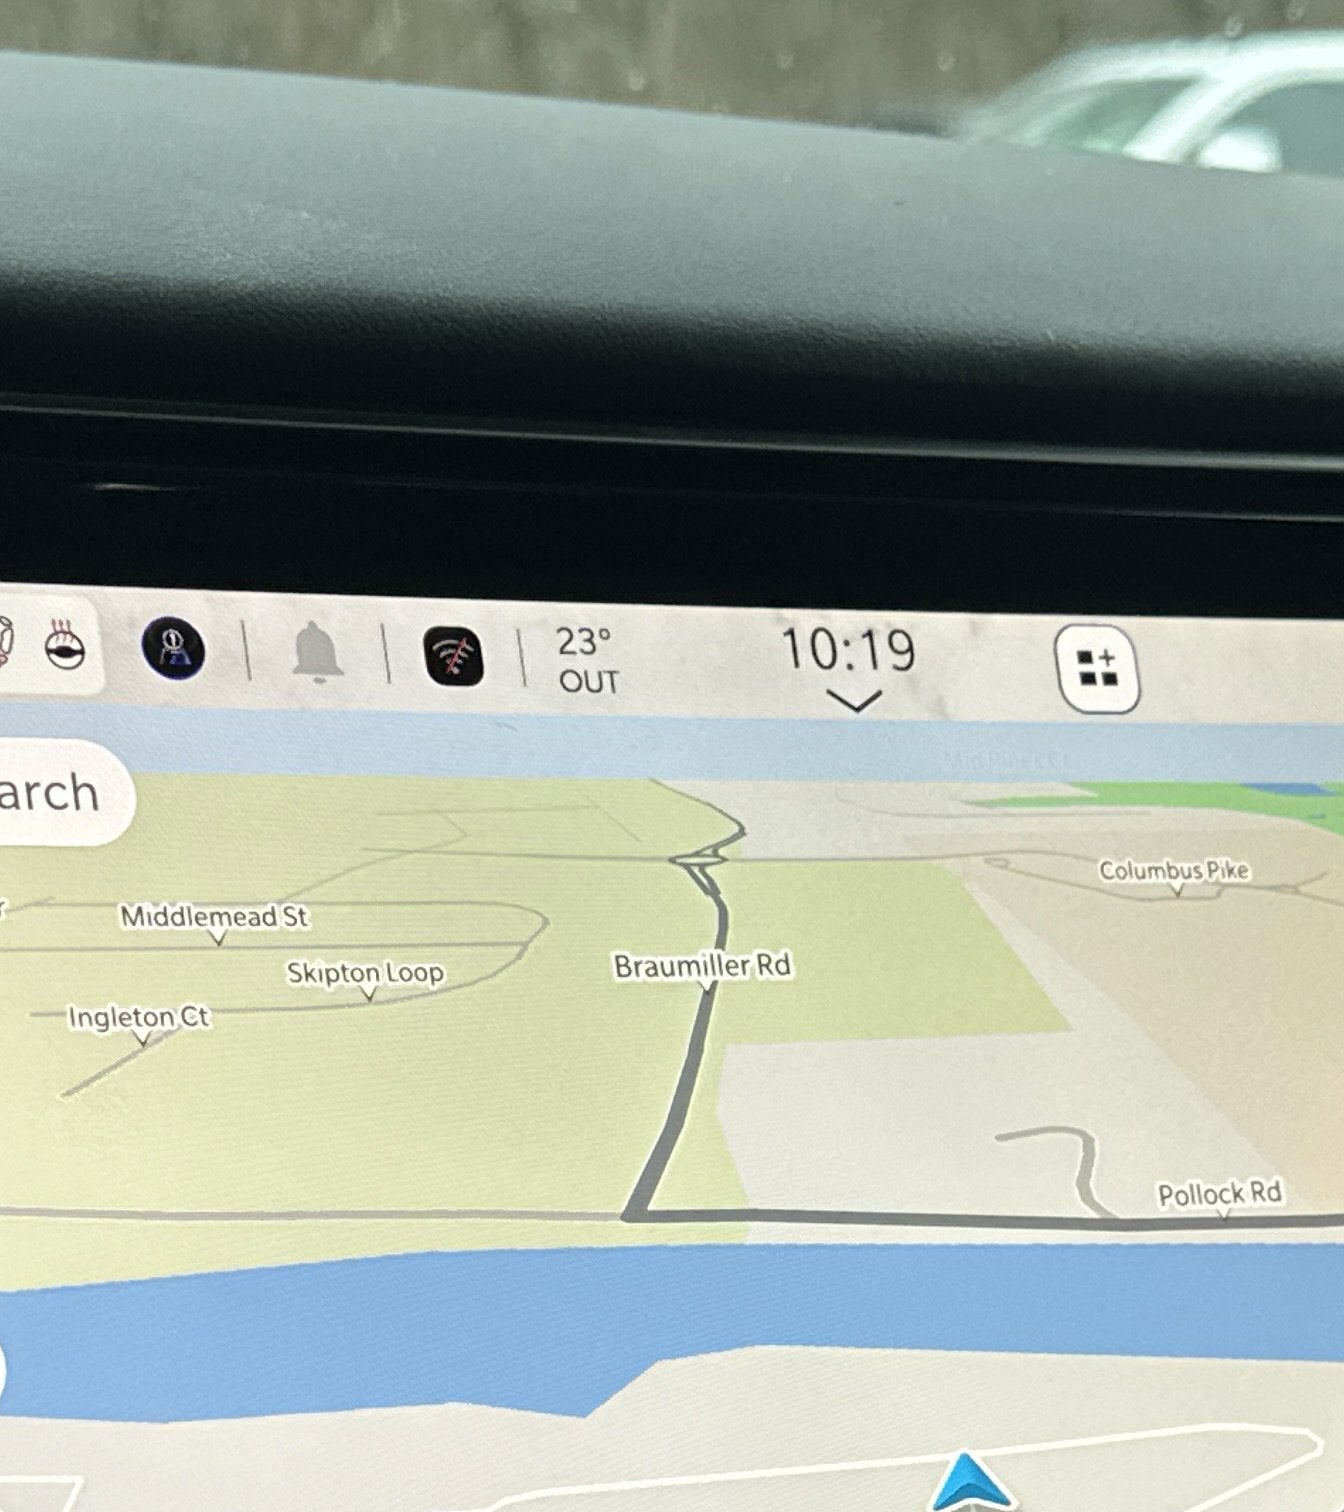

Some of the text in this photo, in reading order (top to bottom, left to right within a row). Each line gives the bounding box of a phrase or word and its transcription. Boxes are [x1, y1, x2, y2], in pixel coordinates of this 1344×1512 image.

[782, 626, 916, 672] 10:19
[559, 669, 620, 694] OUT
[1099, 860, 1249, 882] Columbus Pike
[120, 905, 309, 929] Middlemead St
[287, 961, 444, 987] Skipton Loop
[614, 953, 791, 980] Braumiller Rd
[68, 1005, 210, 1033] Ingleton Ct
[1158, 1180, 1283, 1207] Pollock Rd
